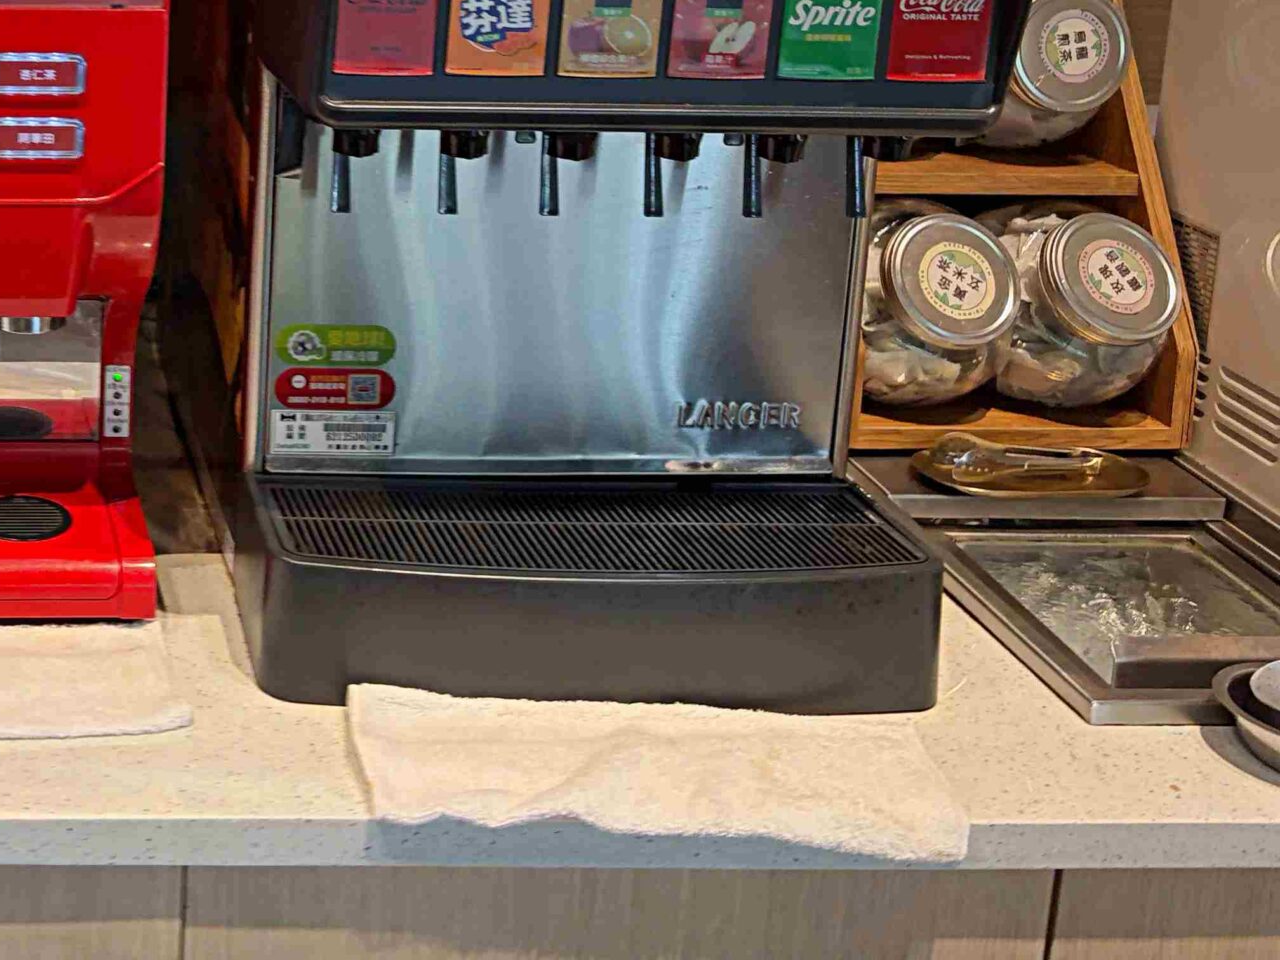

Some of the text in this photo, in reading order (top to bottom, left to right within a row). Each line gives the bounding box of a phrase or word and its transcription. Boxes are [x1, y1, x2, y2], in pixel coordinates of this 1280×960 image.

[789, 0, 877, 31] Sprite
[903, 13, 980, 21] ORIGINAL TASTE
[936, 255, 983, 291] 玄米茶
[1098, 264, 1126, 294] 玫瑰
